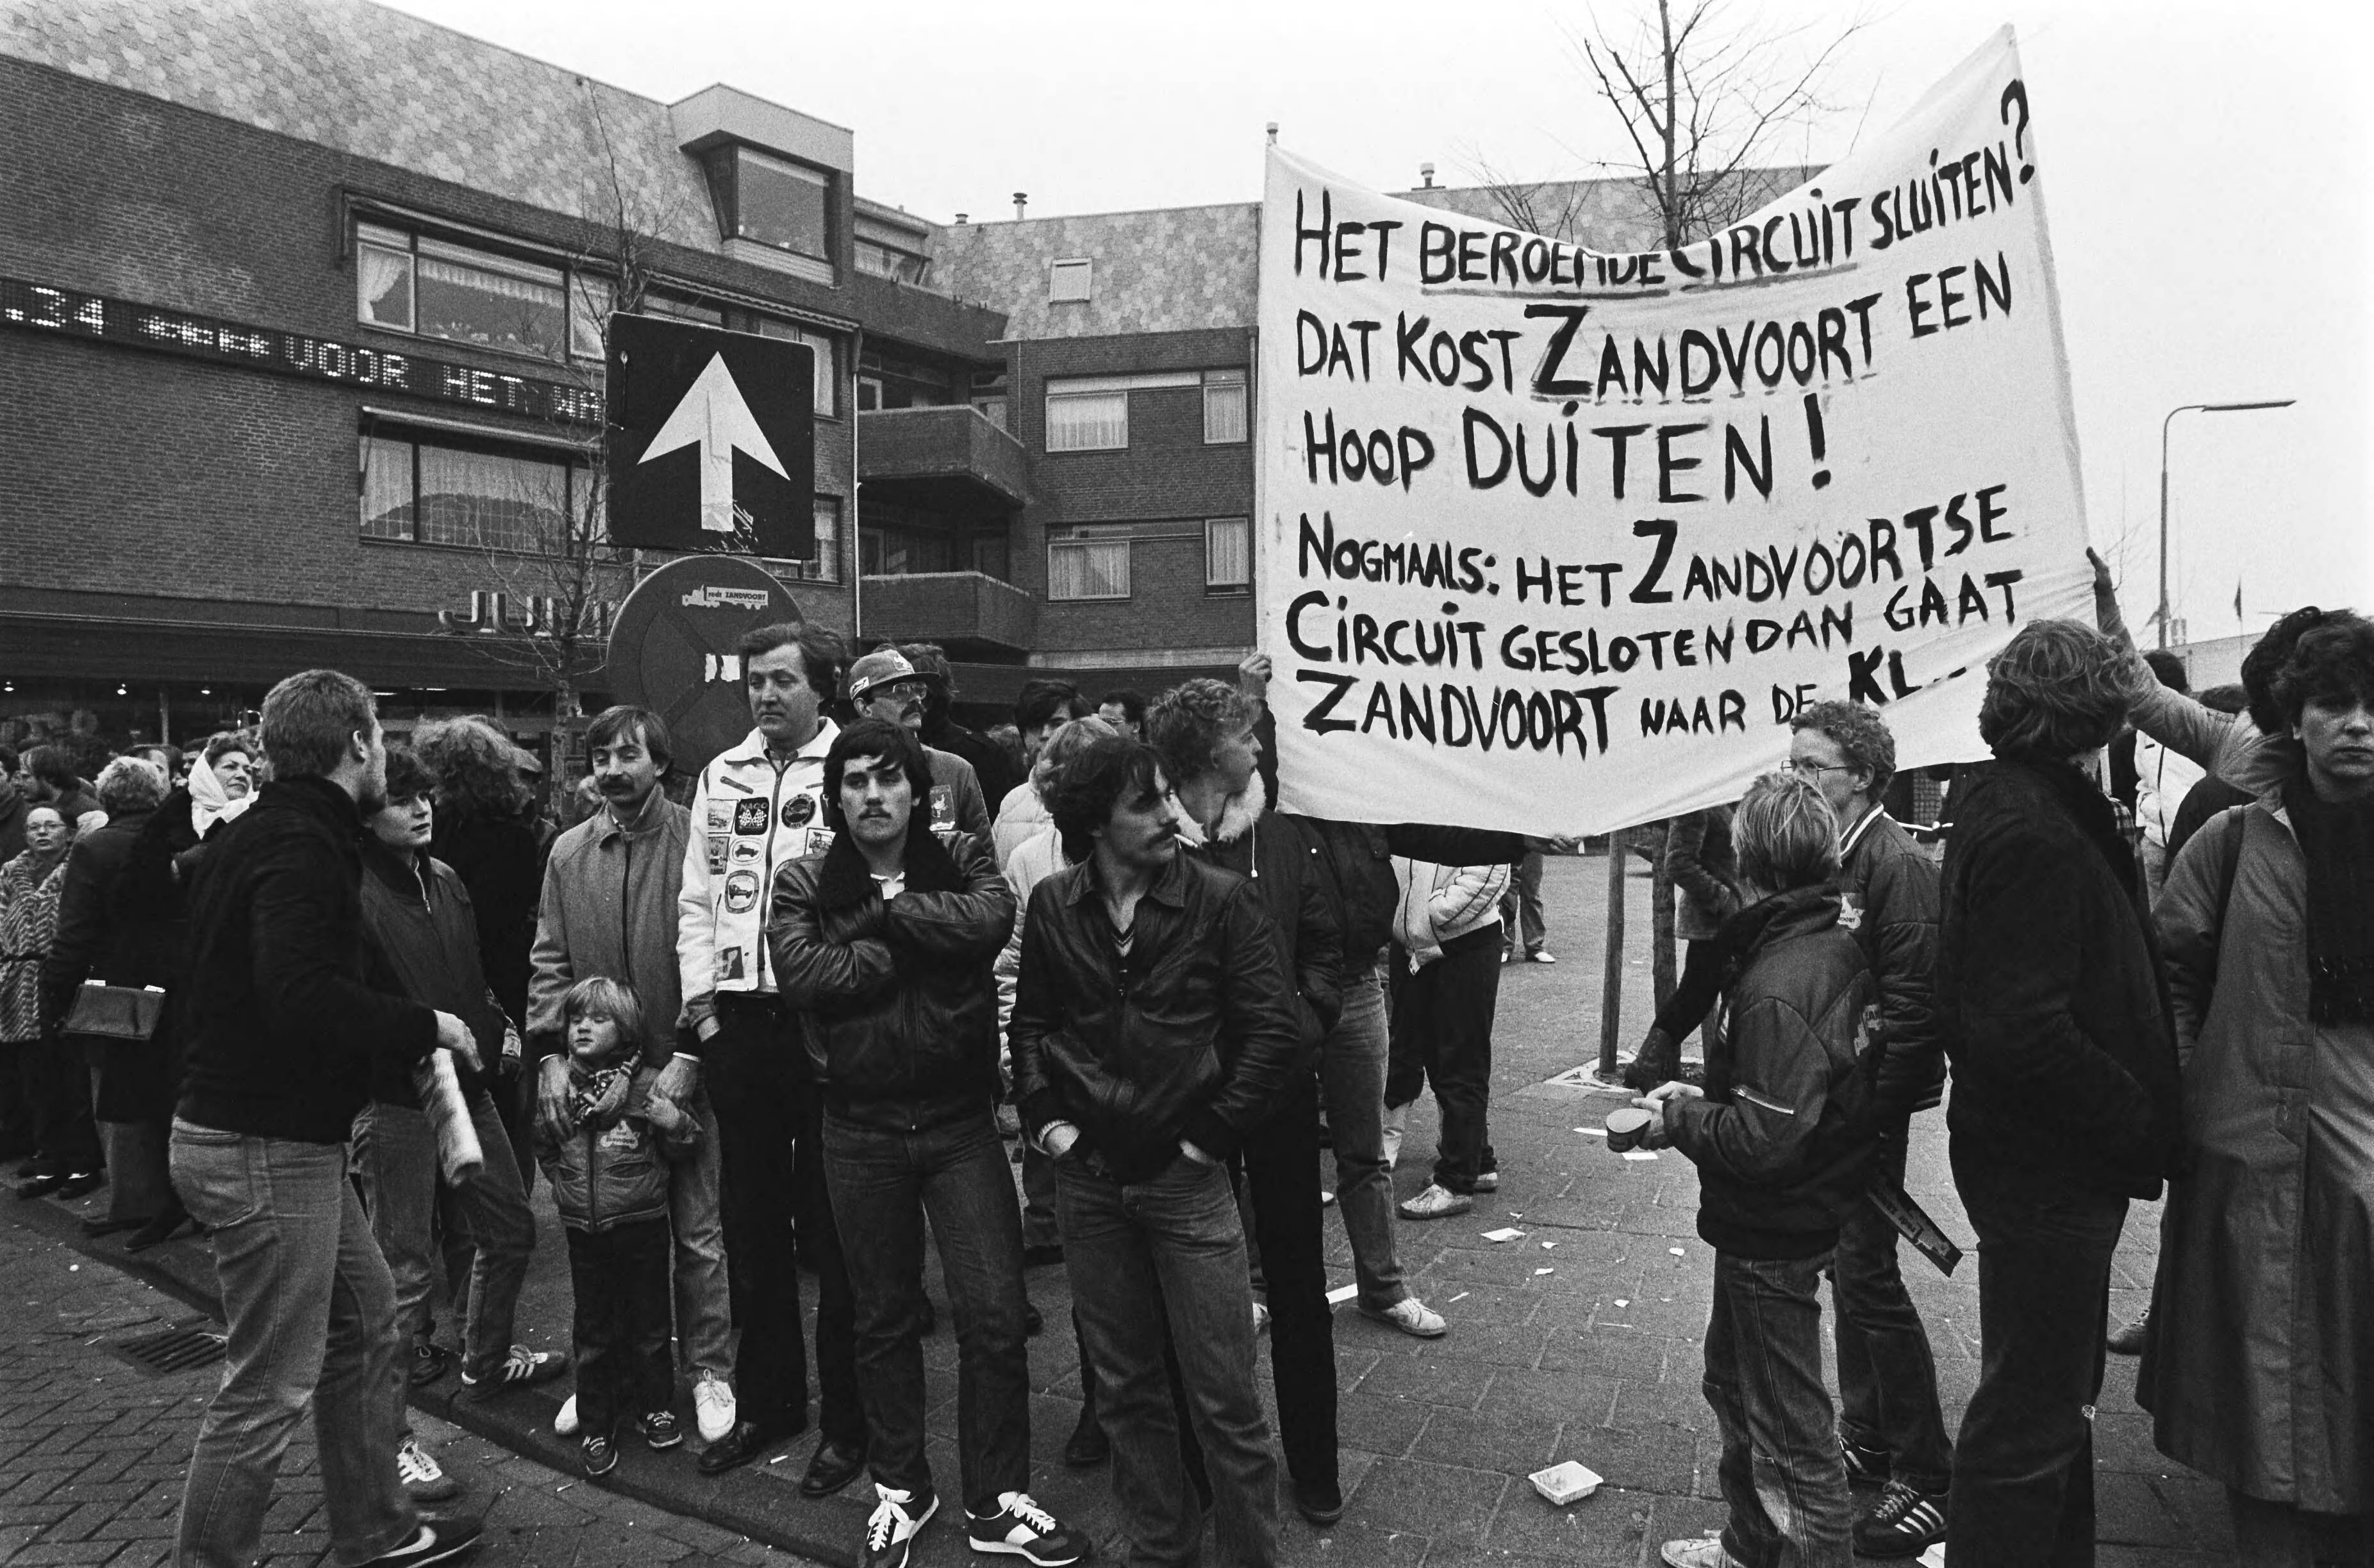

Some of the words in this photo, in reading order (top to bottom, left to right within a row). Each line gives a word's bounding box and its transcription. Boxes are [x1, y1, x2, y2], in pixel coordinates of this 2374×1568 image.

[1294, 186, 1404, 284] HET
[285, 335, 409, 388] VOOR
[443, 364, 523, 407] HET
[1297, 308, 1382, 383] DAT
[1397, 310, 1523, 395] KOST
[1523, 292, 1883, 400] ZANDVOORT
[1906, 251, 2012, 338] EEN
[1304, 407, 1436, 493] HOOP
[1516, 555, 1623, 608] HET
[1629, 484, 2014, 604] ZANDVOORTSE
[1500, 617, 1734, 676] GESLOTEN
[1745, 600, 1854, 654] DAN
[1884, 569, 2024, 632] GAAT
[1296, 668, 1622, 761] ZANDVOORT
[1640, 689, 1746, 738] NAAR
[1772, 683, 1817, 724] DE
